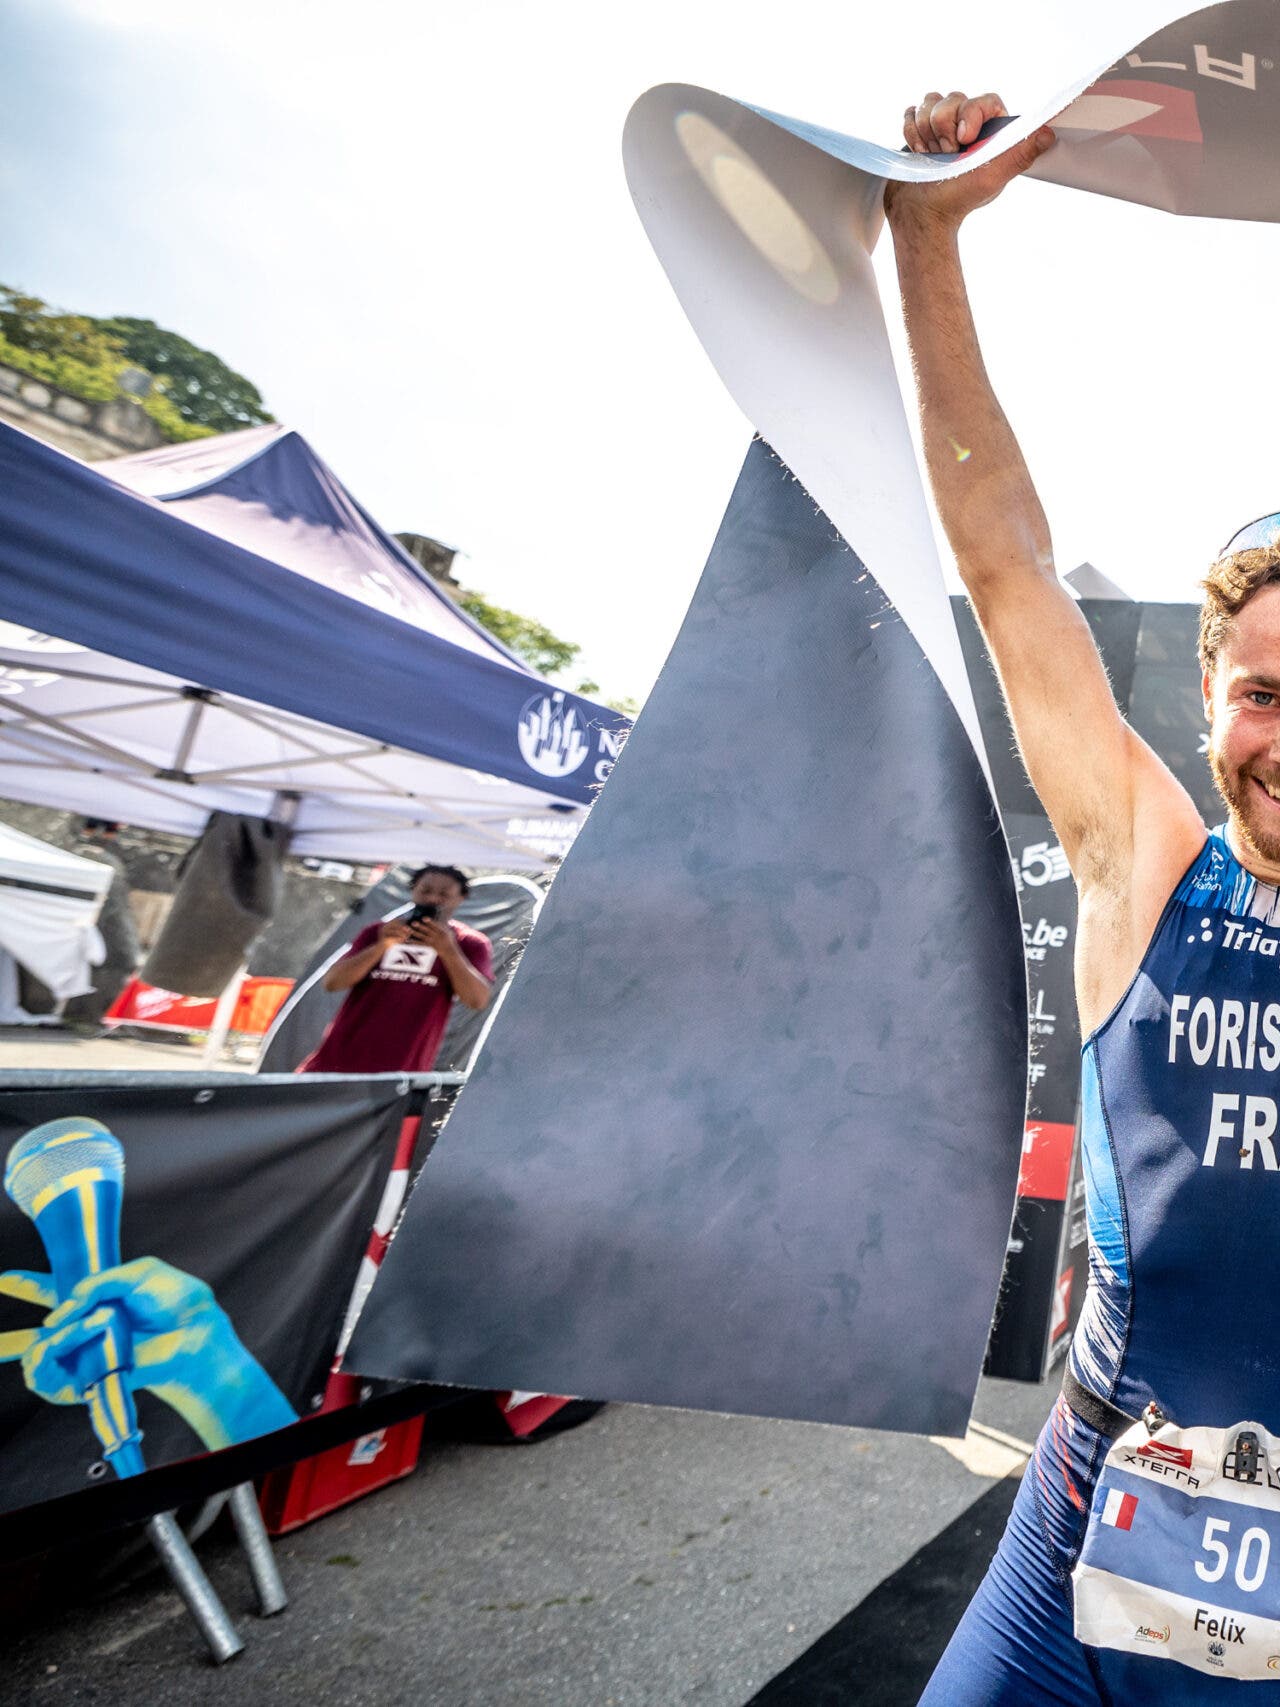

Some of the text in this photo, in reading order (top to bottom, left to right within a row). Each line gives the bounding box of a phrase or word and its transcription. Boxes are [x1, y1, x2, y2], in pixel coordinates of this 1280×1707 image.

[1123, 1454, 1200, 1489] XTERRA
[1194, 1517, 1271, 1593] 50
[1135, 1625, 1164, 1641] Adeps
[1193, 1608, 1246, 1645] Felix
